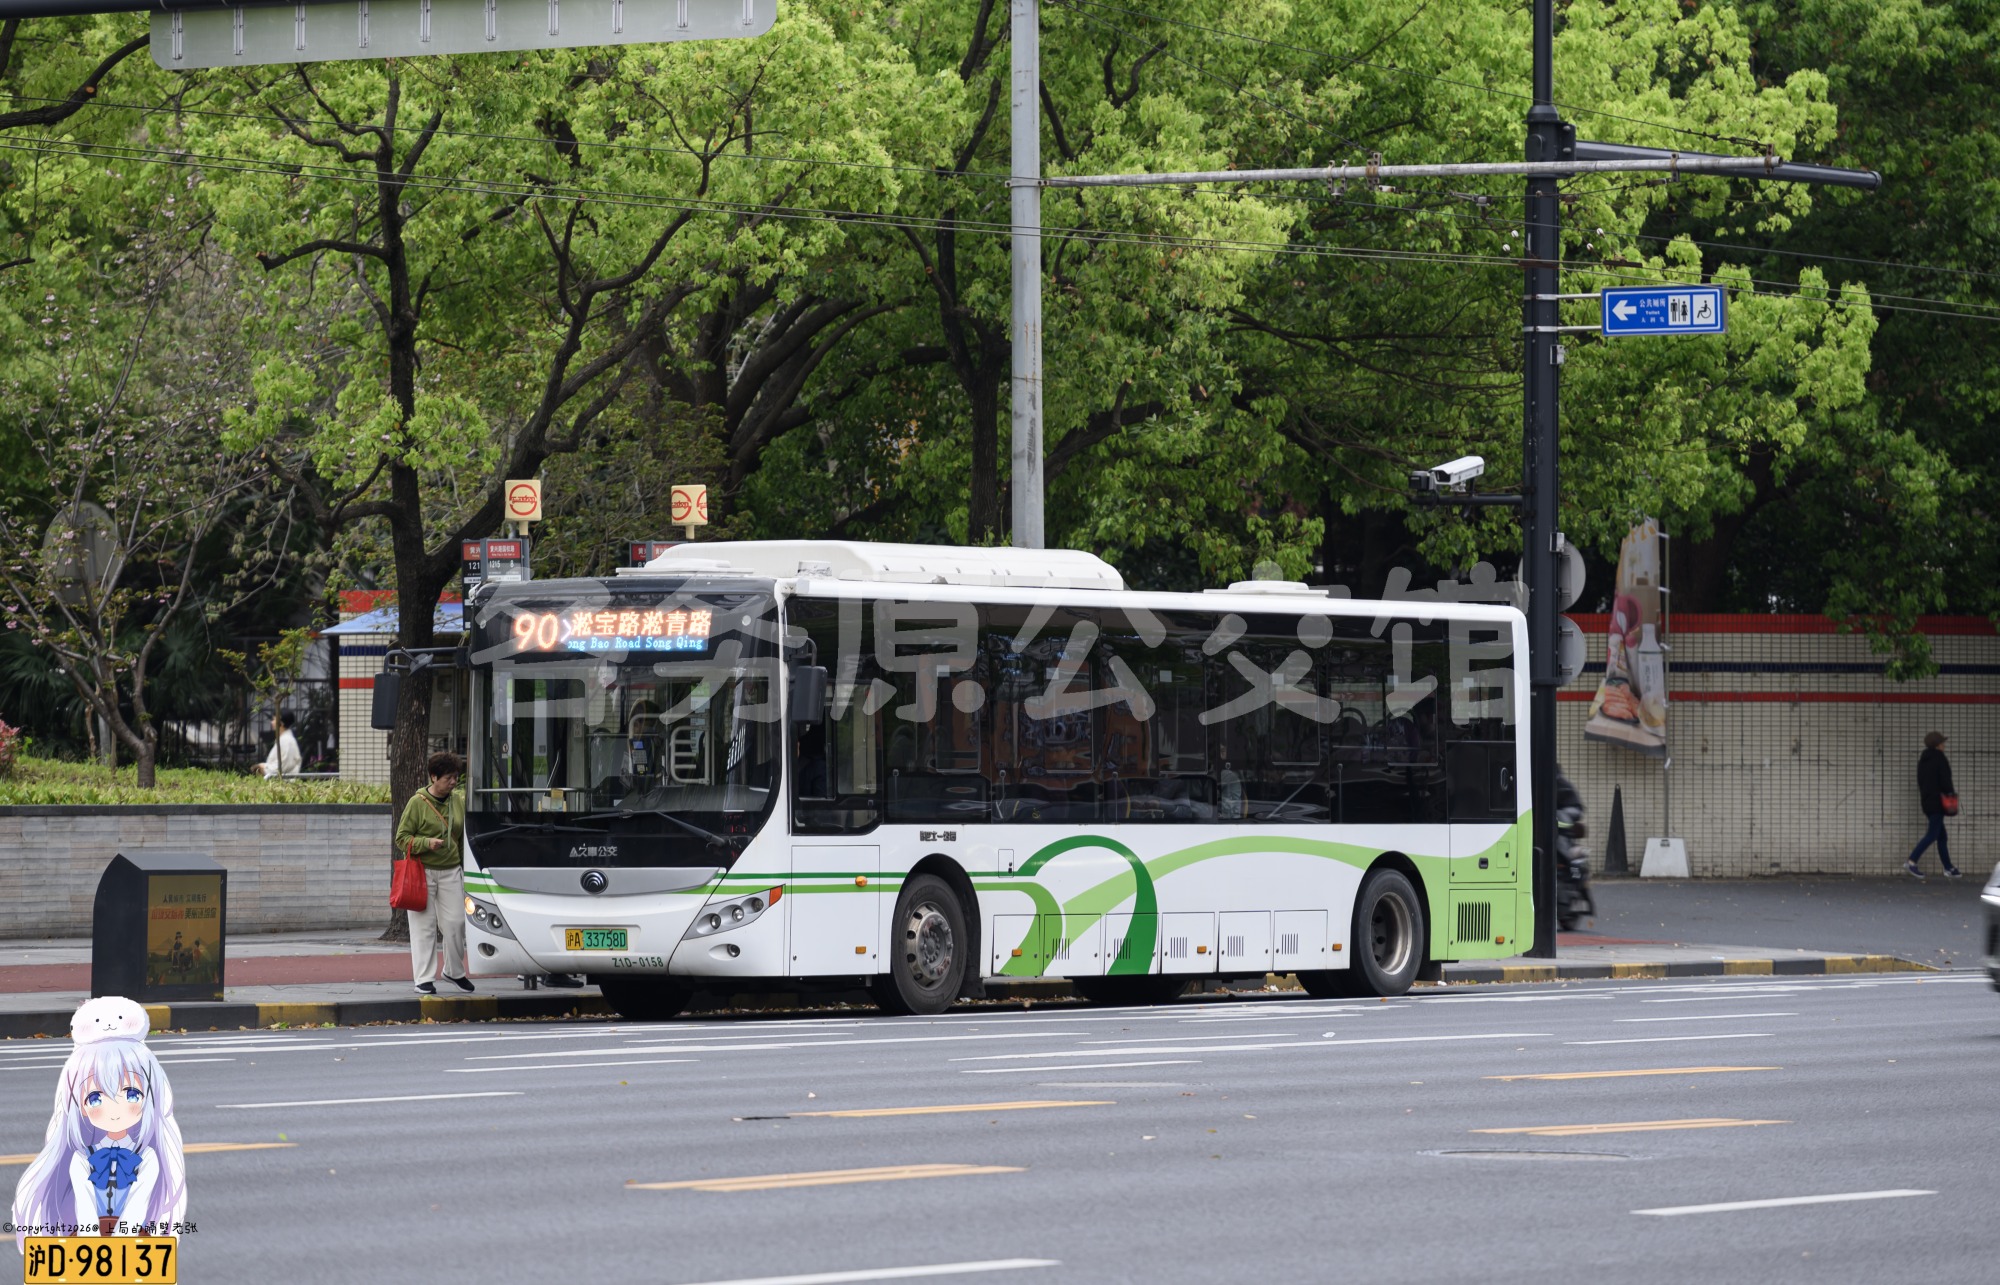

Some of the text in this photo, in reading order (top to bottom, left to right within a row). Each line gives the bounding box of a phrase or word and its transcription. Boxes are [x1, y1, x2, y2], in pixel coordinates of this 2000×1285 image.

[1639, 298, 1666, 308] 公共厕所
[571, 610, 712, 637] 淞宝路淞青路
[514, 613, 558, 650] 90
[568, 636, 703, 650] ng Bao Road Song Qing
[612, 956, 664, 968] Z1D-0158
